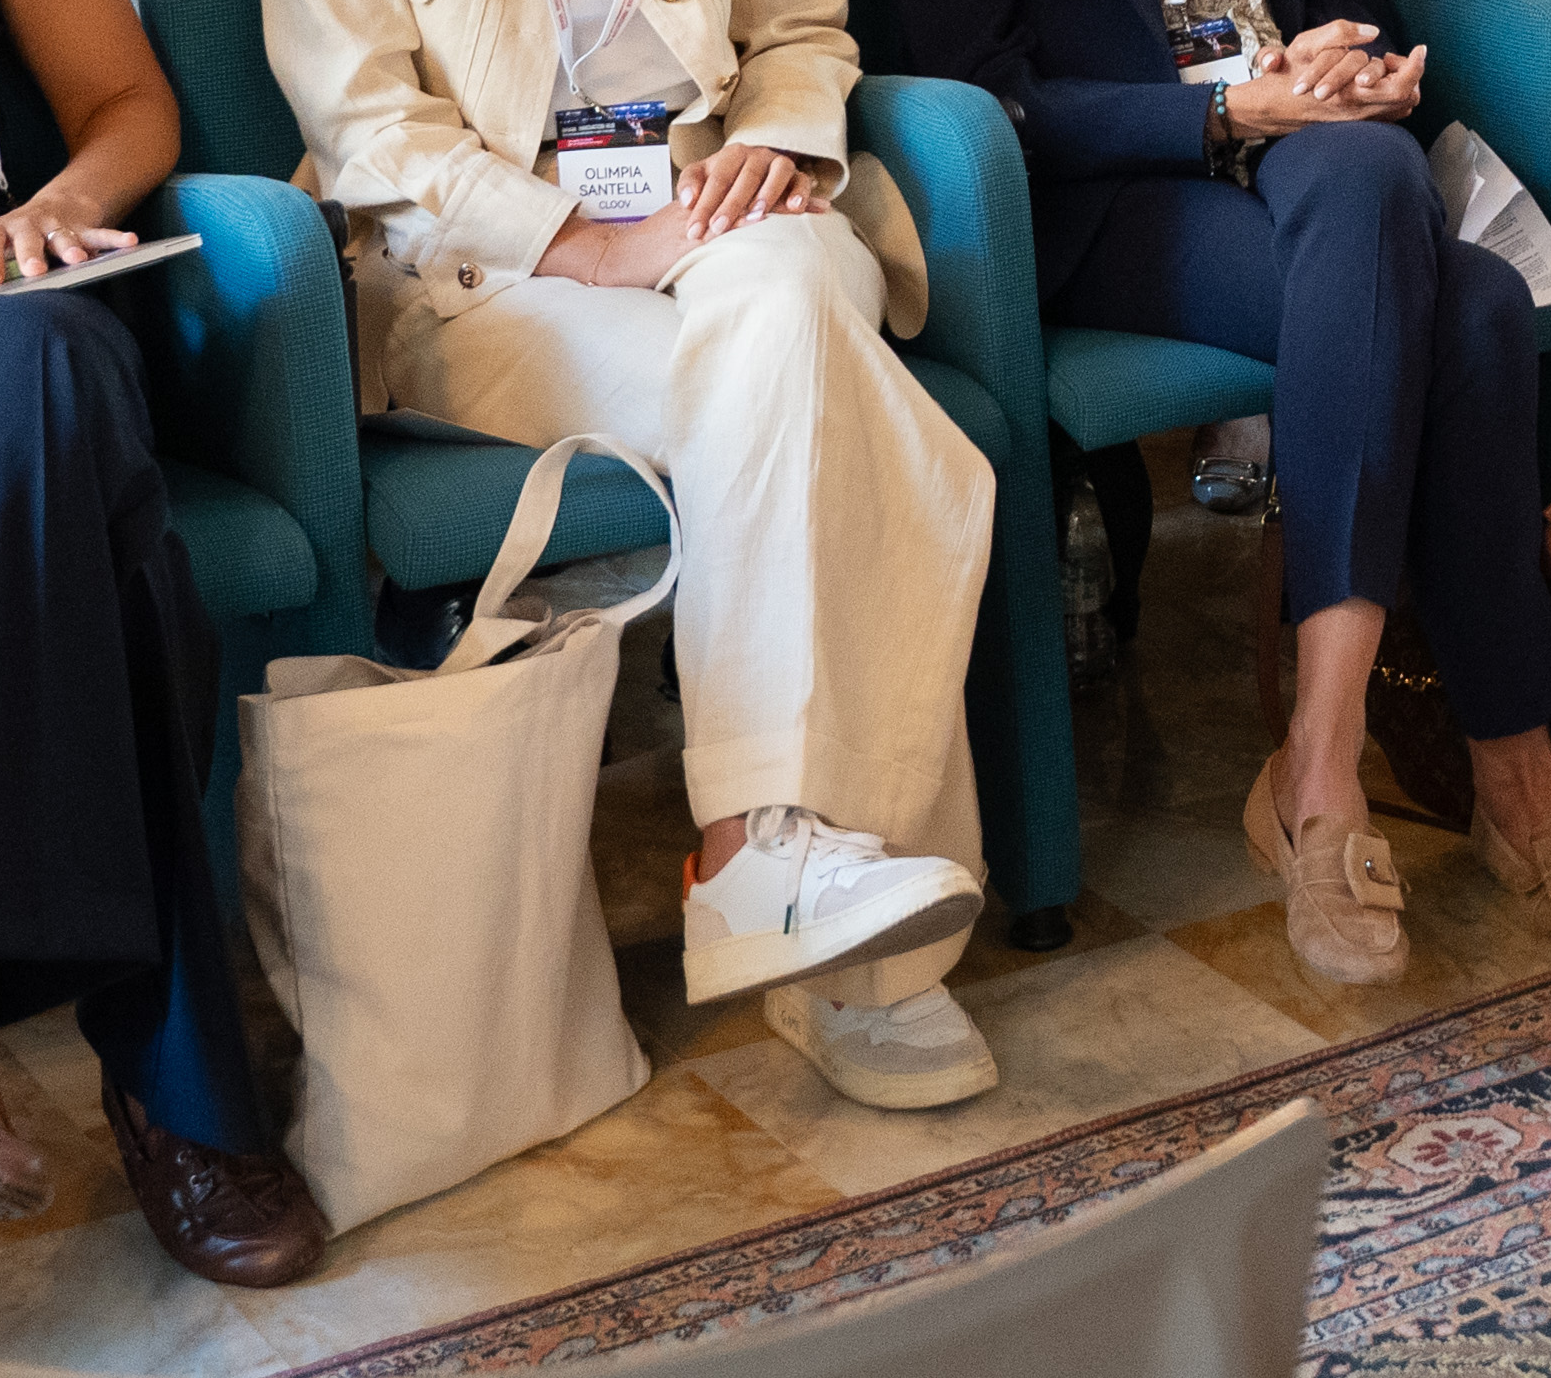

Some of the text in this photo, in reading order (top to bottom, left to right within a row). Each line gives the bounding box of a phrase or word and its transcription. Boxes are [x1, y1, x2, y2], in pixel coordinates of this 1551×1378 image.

[585, 166, 643, 180] OLIMPIA
[579, 182, 652, 197] SANTELLA
[599, 200, 632, 209] CLOOV
